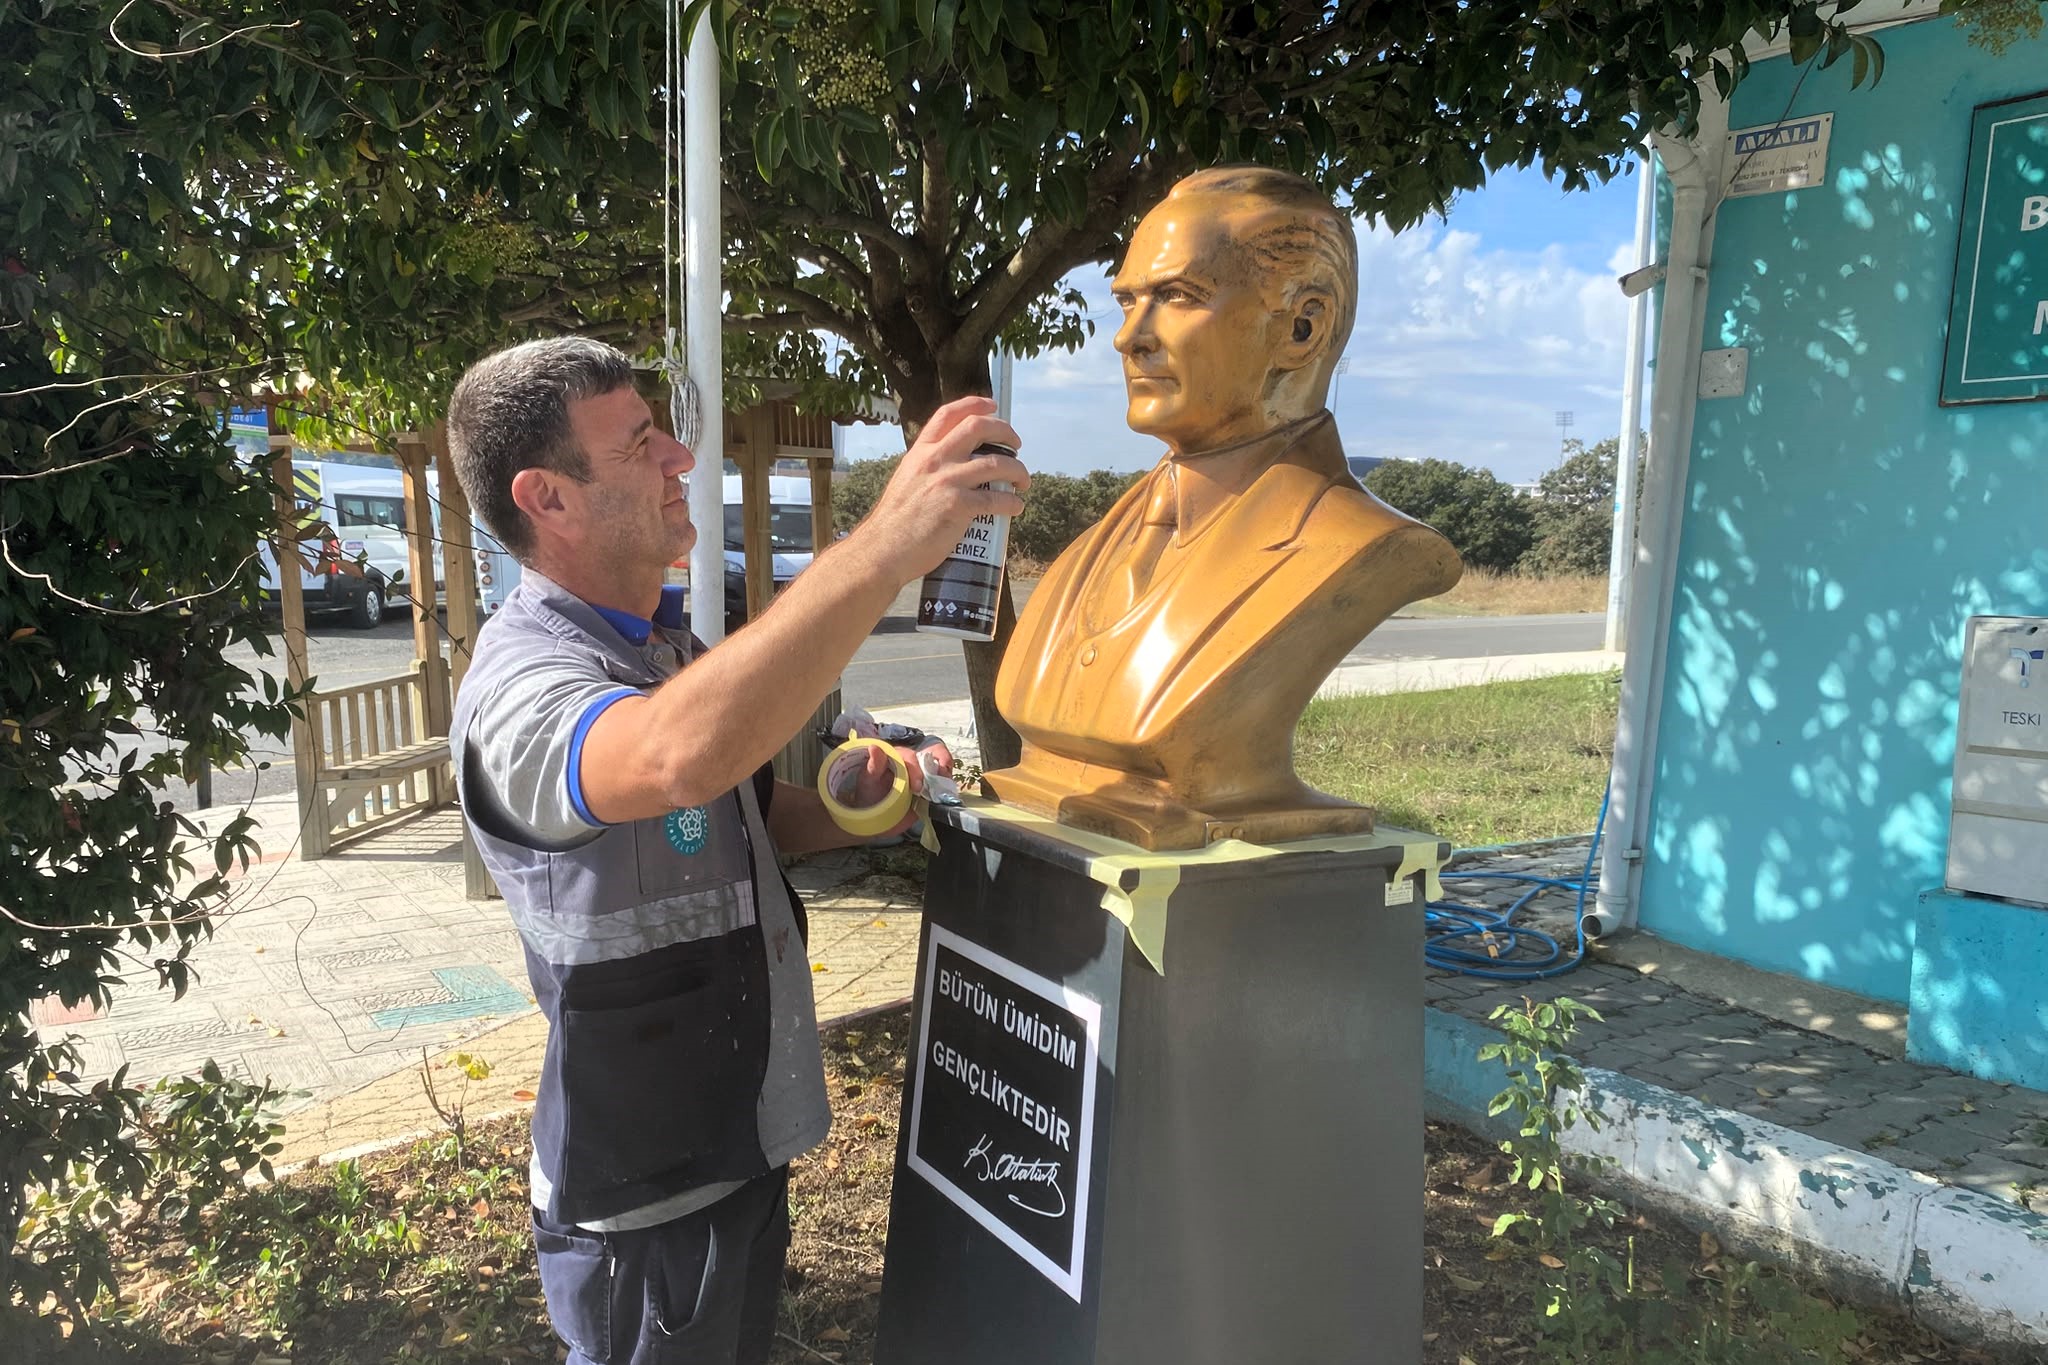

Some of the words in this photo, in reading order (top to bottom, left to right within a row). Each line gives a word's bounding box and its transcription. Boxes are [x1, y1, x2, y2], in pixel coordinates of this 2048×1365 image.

[951, 543, 989, 559] EMEZ.
[939, 969, 998, 1024] BÜTÜN
[1003, 999, 1076, 1069] ÜMİDİM
[932, 1040, 1071, 1152] GENÇLİKTEDİR
